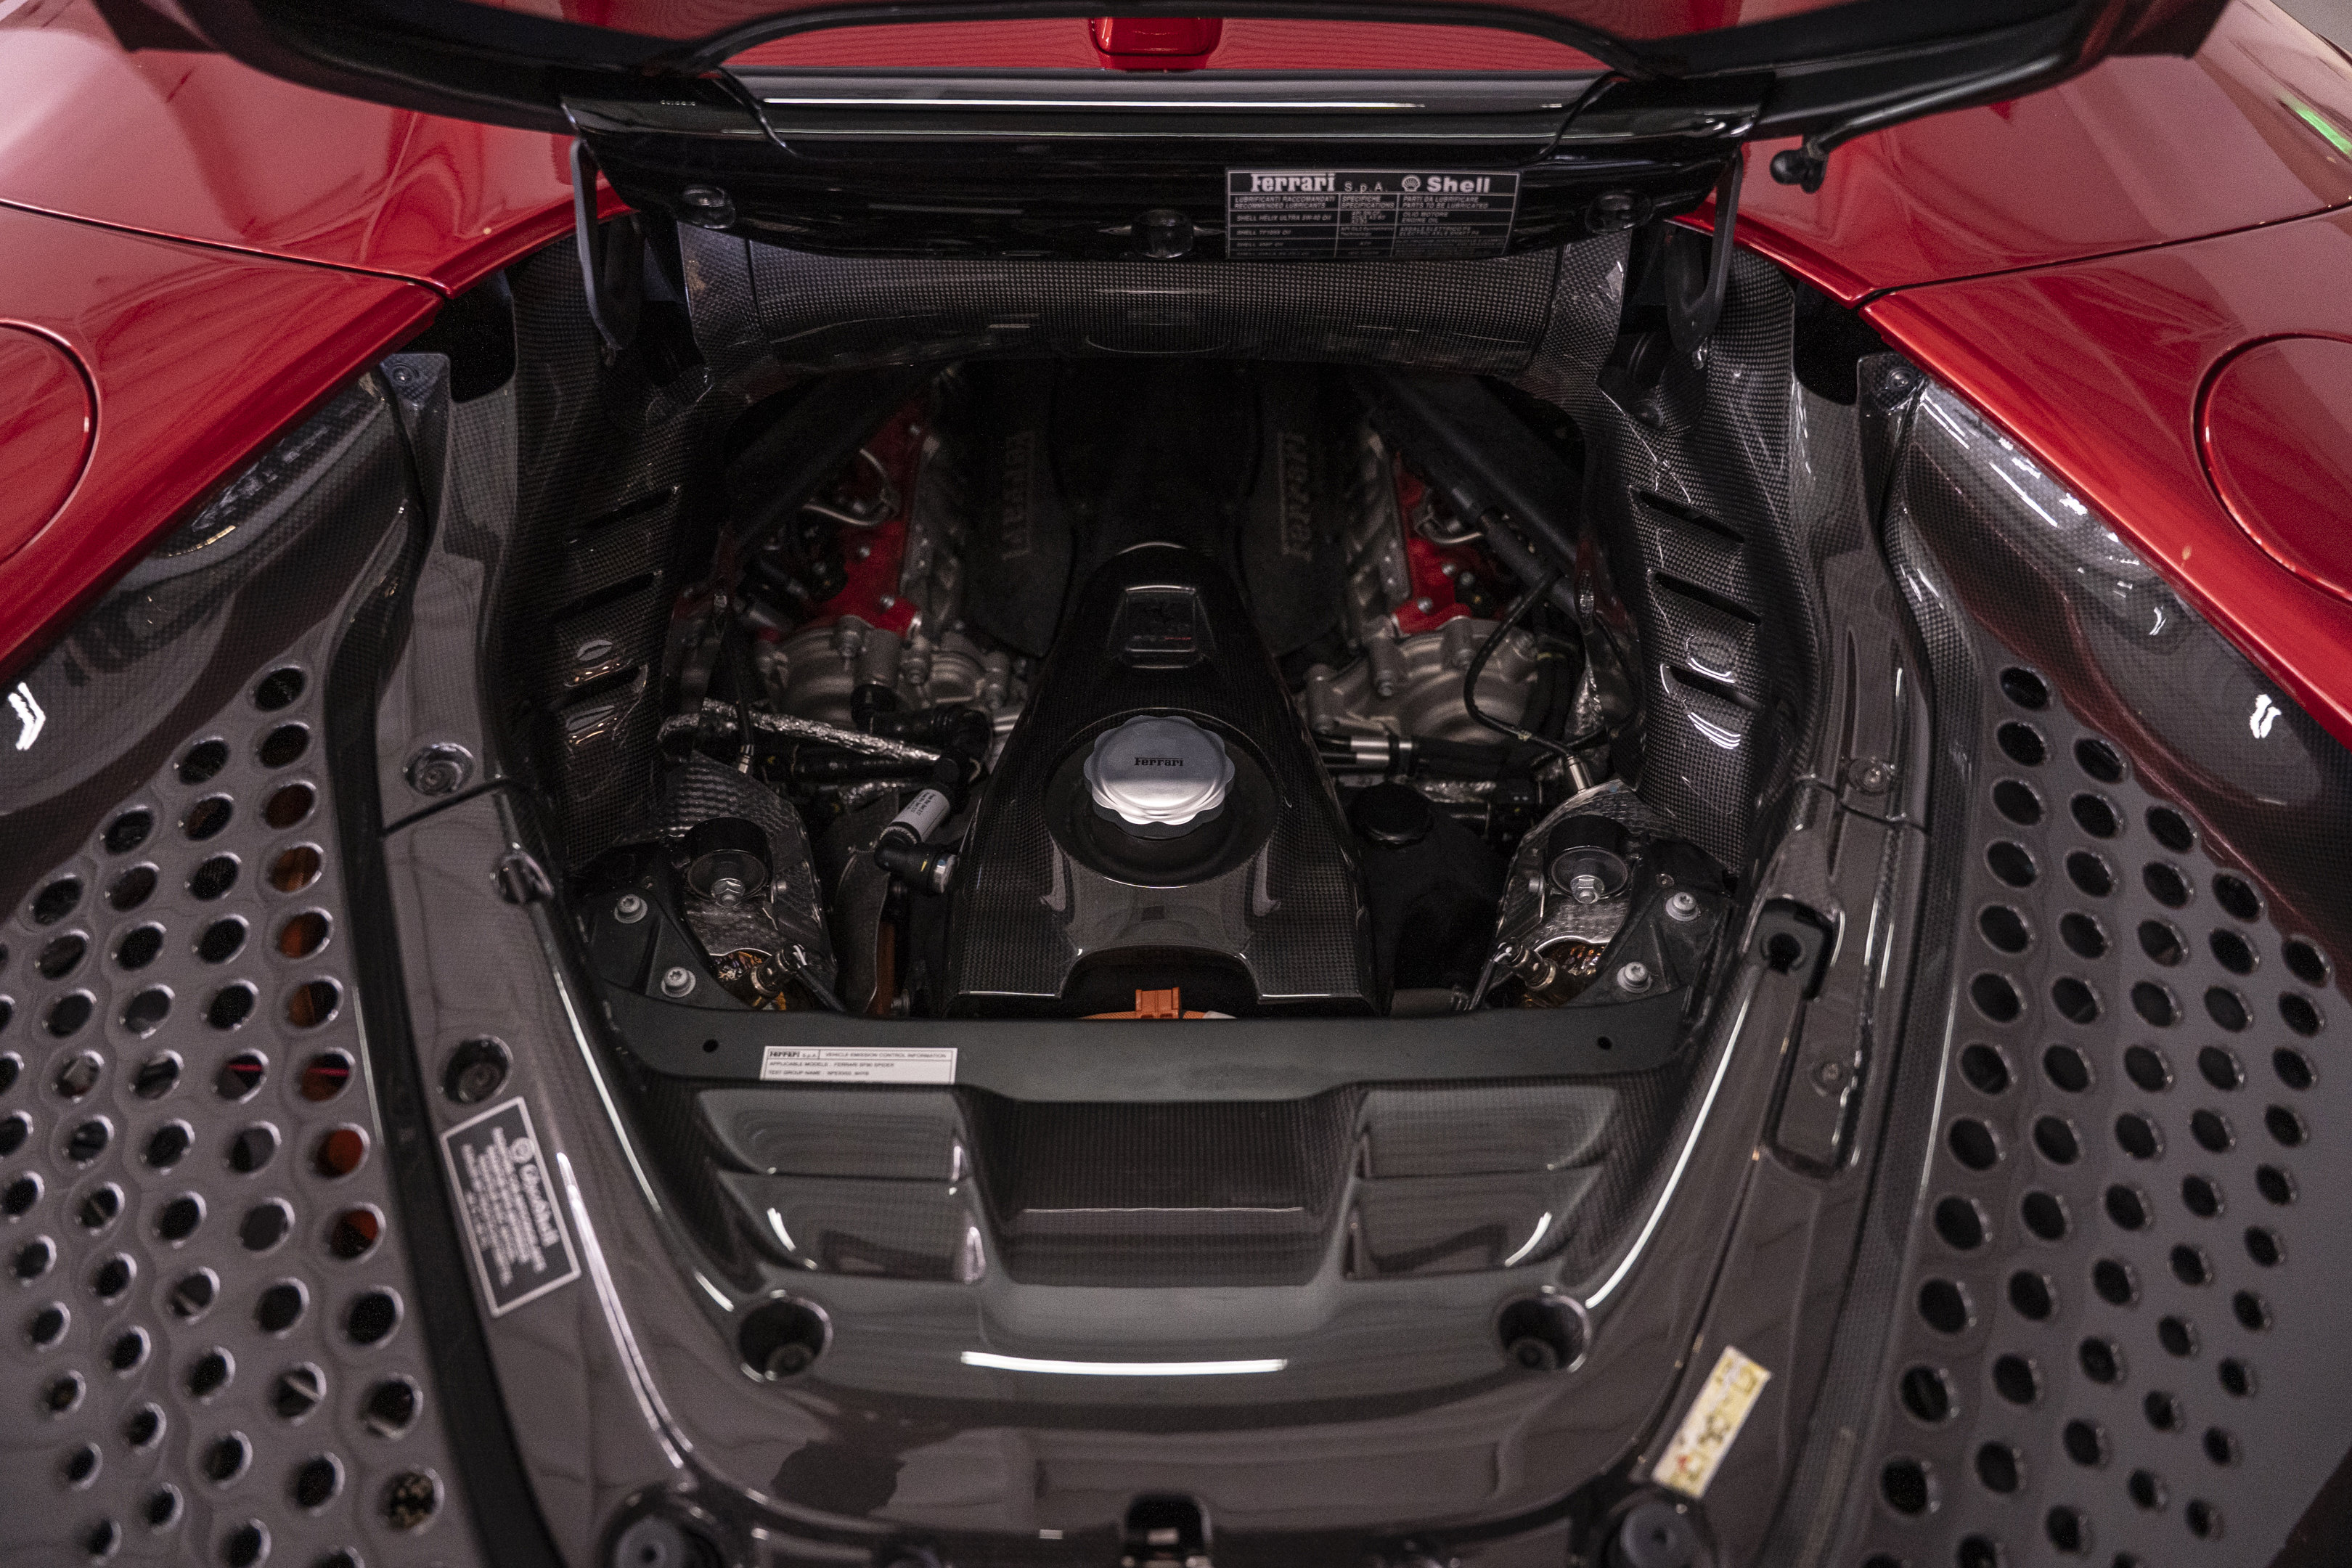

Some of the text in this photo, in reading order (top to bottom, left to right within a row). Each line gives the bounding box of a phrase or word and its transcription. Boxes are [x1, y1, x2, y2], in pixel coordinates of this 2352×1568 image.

[1250, 173, 1336, 192] Ferrari
[1426, 175, 1490, 193] Shell
[1134, 756, 1184, 767] Ferrari
